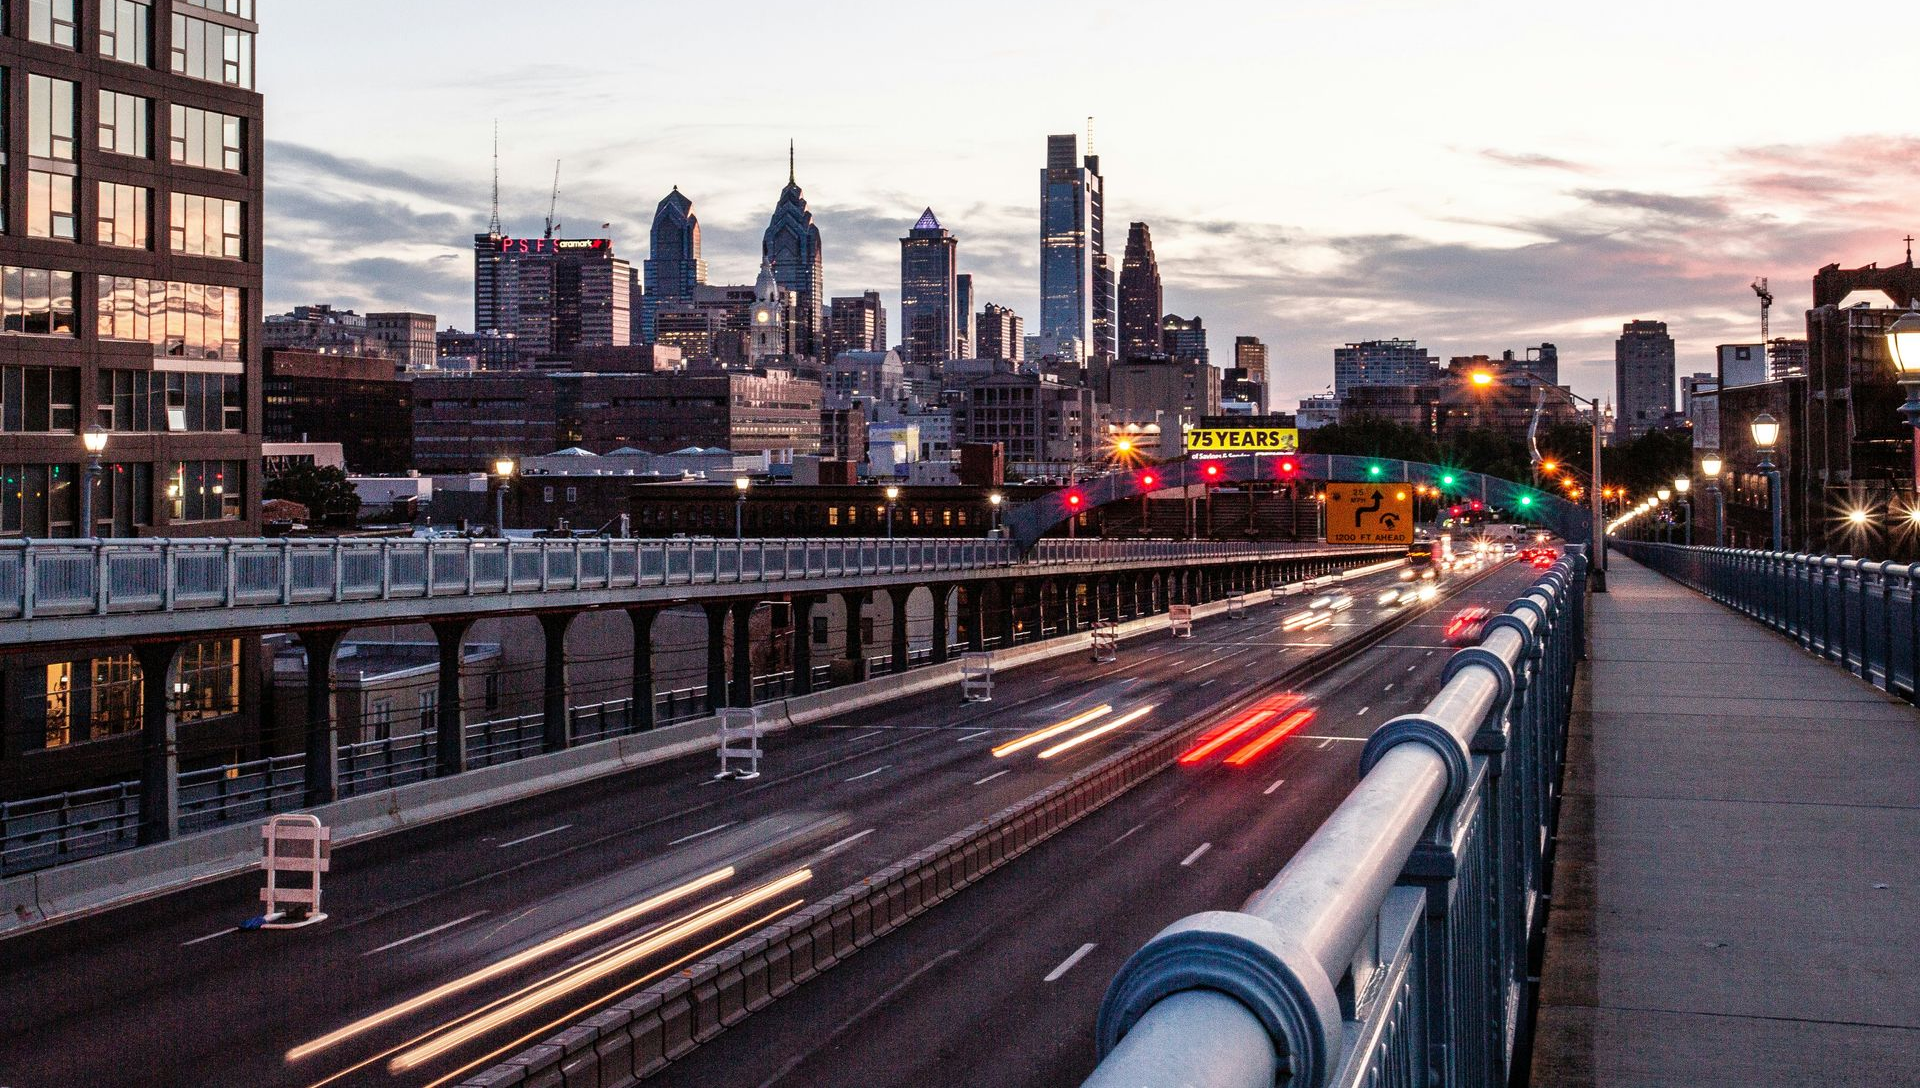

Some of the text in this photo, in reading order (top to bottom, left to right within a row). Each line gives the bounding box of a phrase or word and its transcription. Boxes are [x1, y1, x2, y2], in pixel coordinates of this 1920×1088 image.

[560, 240, 592, 248] aramark
[1191, 431, 1280, 447] 75 YEARS
